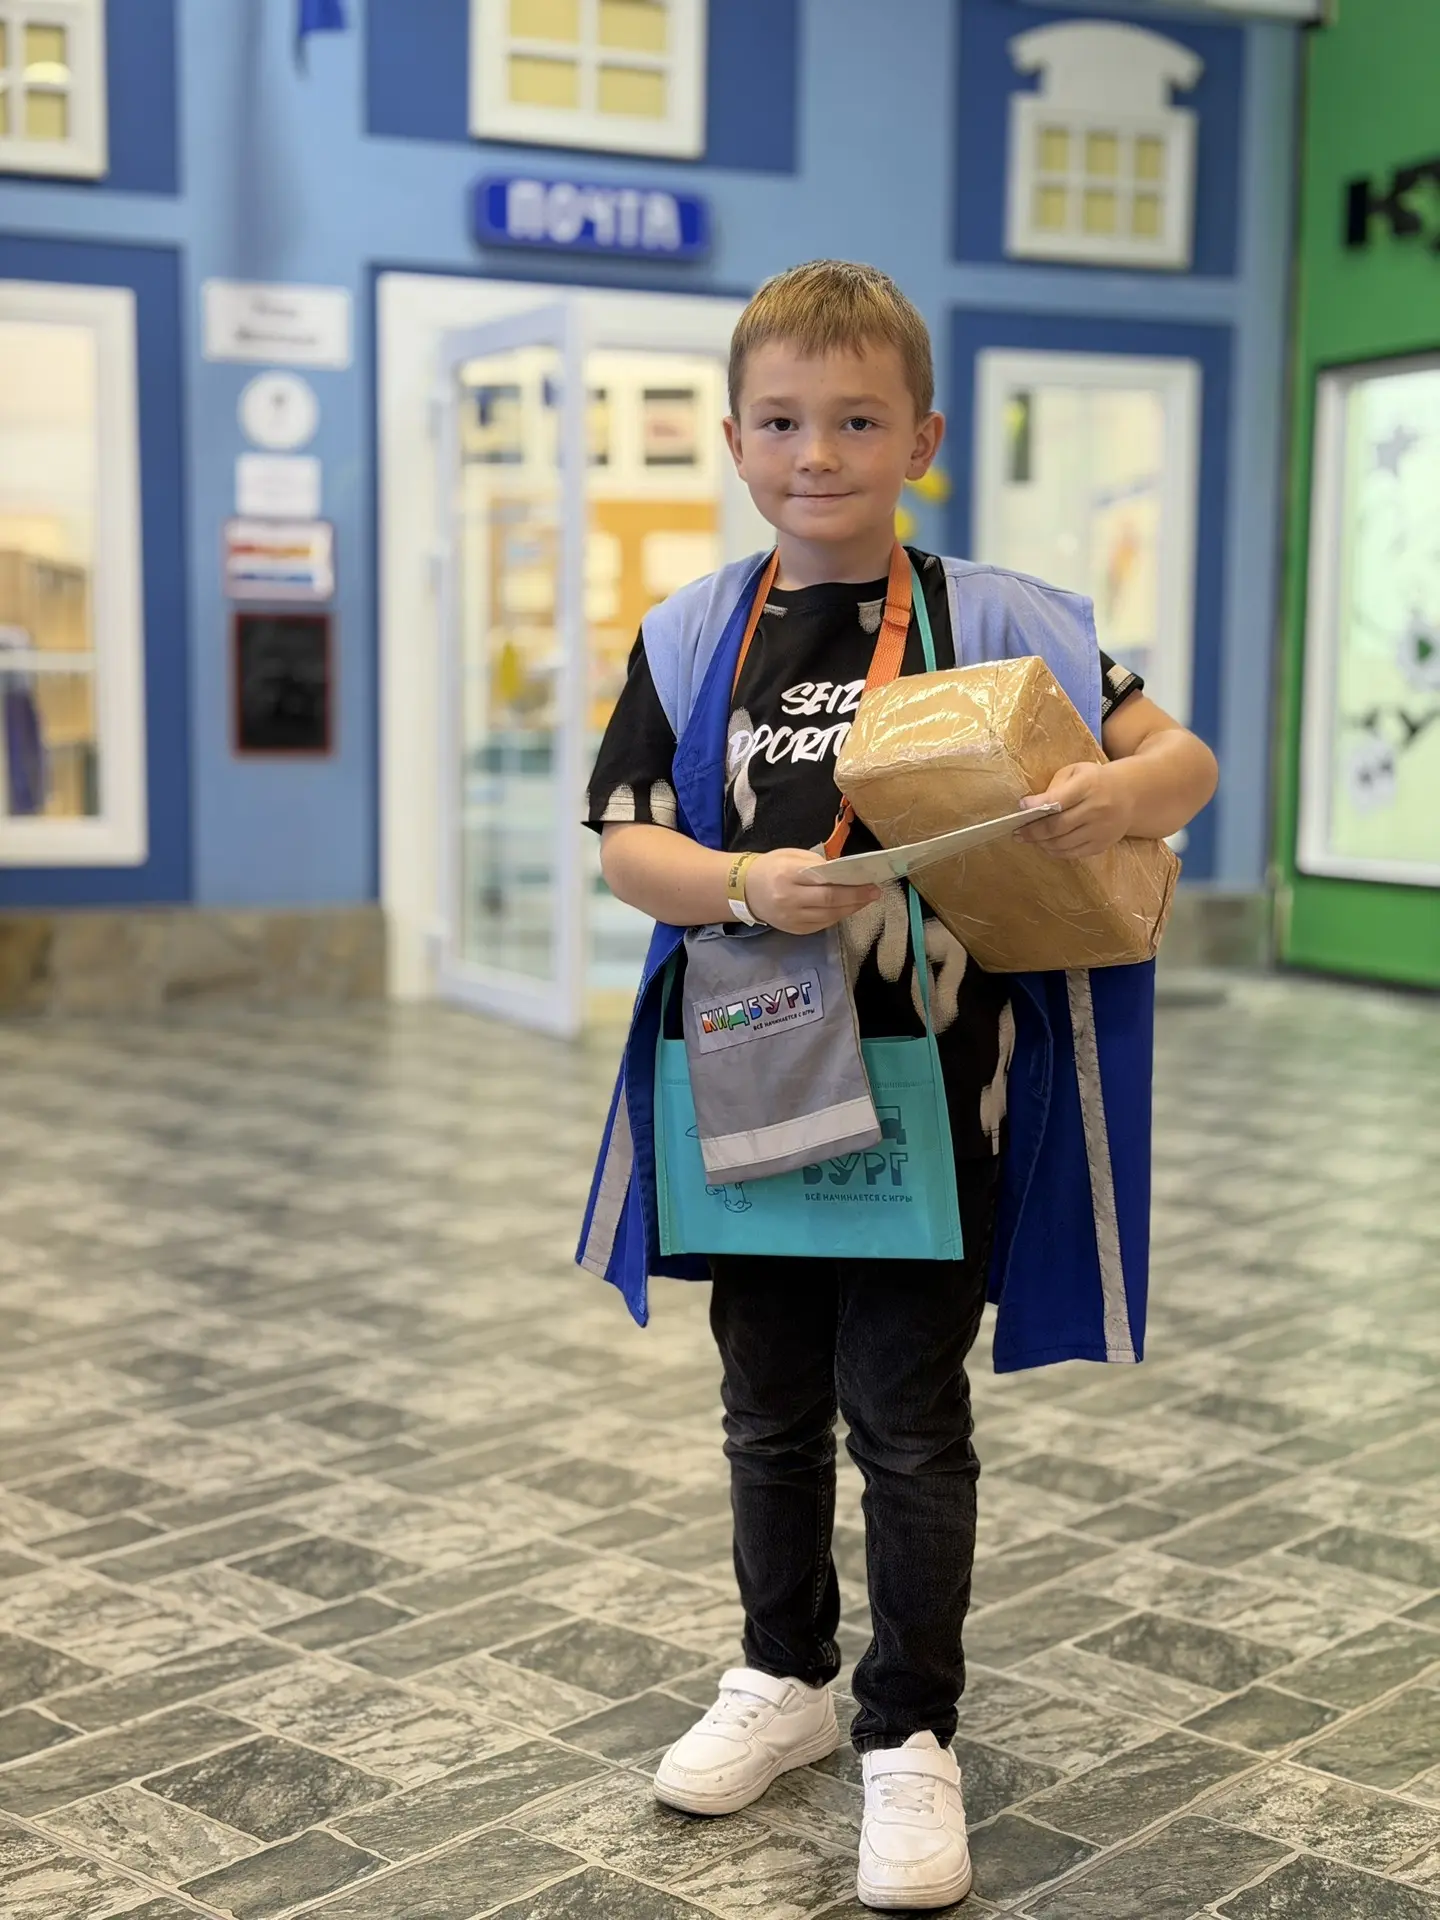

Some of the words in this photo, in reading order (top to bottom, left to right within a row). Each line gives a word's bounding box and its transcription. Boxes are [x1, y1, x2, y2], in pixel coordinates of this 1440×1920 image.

[506, 180, 682, 250] ПОЧТА
[700, 981, 812, 1034] КИДБУРГ
[764, 1013, 798, 1027] НАЧИНАЕТСЯ
[802, 1008, 815, 1017] ИГРЫ
[804, 1192, 820, 1201] ВСЁ
[822, 1193, 880, 1202] НАЧИНАЕТСЯ
[881, 1194, 888, 1202] С
[889, 1194, 913, 1203] ИГРЫ
